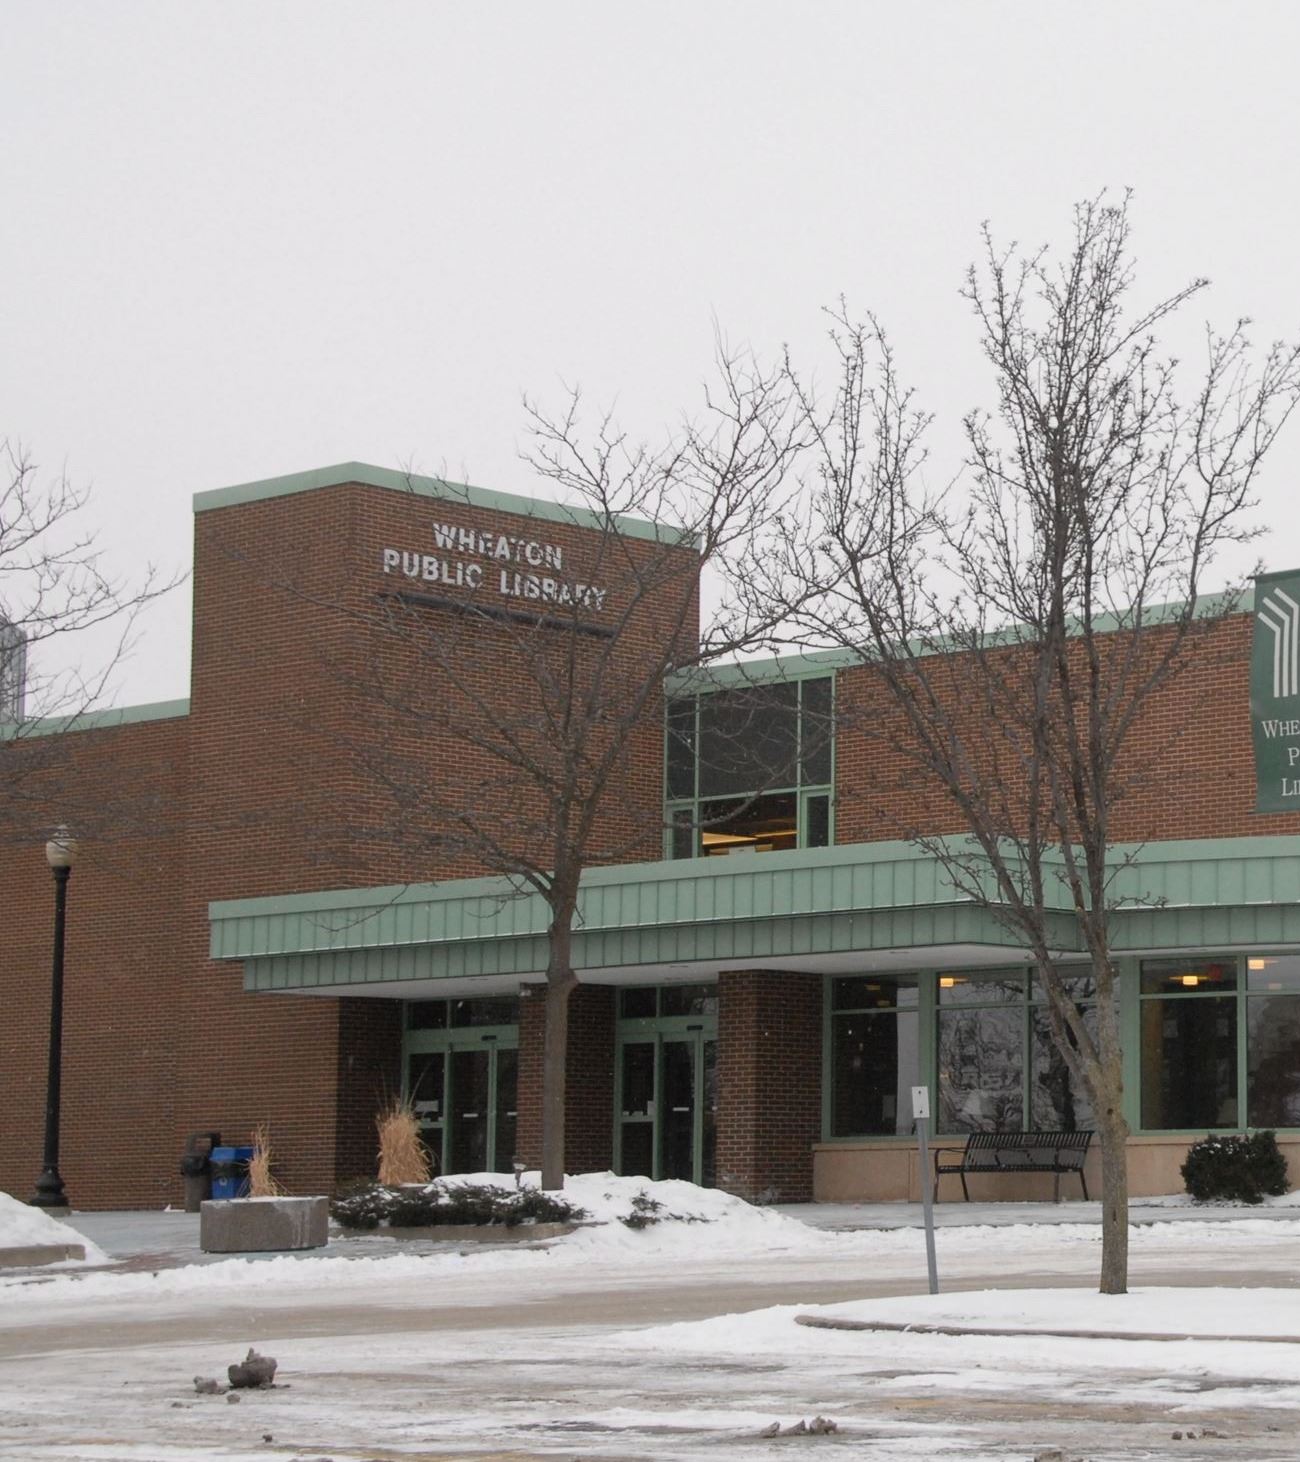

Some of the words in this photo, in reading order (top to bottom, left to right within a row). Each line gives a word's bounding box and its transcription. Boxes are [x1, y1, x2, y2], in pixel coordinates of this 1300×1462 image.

[432, 522, 562, 570] WHEATON
[383, 548, 483, 589] PUBLIC
[500, 570, 607, 611] LIBRARY
